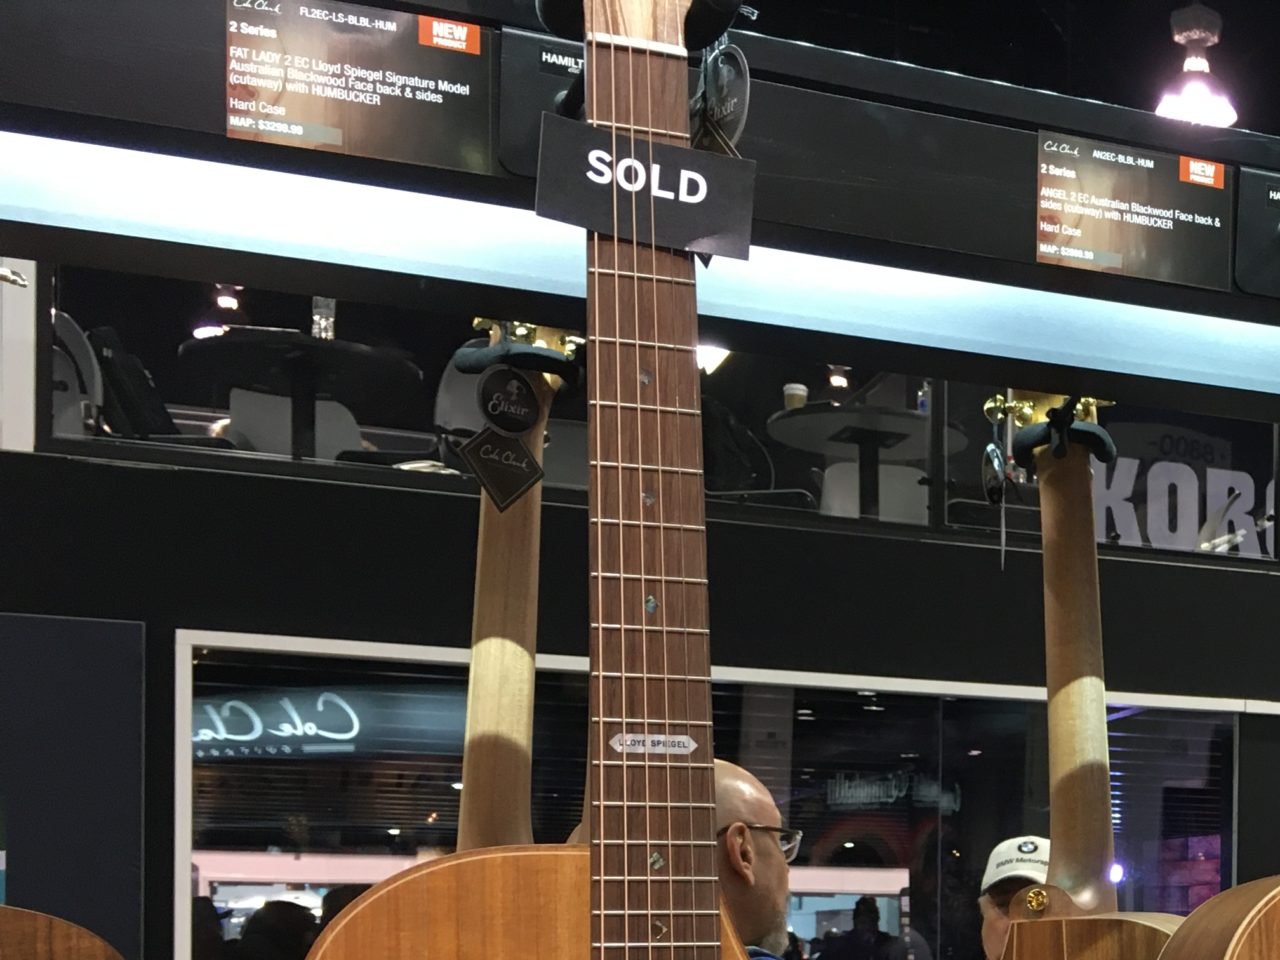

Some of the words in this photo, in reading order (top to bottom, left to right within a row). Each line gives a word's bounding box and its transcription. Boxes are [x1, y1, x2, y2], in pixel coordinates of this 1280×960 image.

[229, 21, 238, 32] 2
[240, 22, 277, 38] Series
[432, 21, 468, 41] NEW
[542, 51, 585, 69] HAMILT
[229, 46, 250, 59] FAT
[252, 50, 281, 64] LADY
[284, 55, 292, 66] 2
[295, 56, 309, 68] EC
[312, 59, 341, 75] Lloyd
[343, 64, 382, 82] Spiegel
[385, 71, 435, 88] Signature
[438, 80, 470, 95] Model
[229, 59, 284, 78] Australian
[287, 67, 345, 87] Blackwood
[348, 77, 373, 92] Face
[376, 82, 402, 97] back
[404, 87, 413, 98] &
[415, 90, 443, 103] sides
[229, 72, 282, 92] (cutaway)
[286, 82, 309, 94] with
[312, 84, 380, 105] HUMBUCKER
[230, 98, 256, 111] Hard
[259, 101, 286, 115] Case
[229, 116, 255, 128] MAP:
[585, 149, 708, 204] SOLD
[1040, 163, 1048, 173] 2
[1049, 165, 1076, 179] Series
[1189, 160, 1215, 178] NEW
[1040, 186, 1068, 200] ANGEL
[1070, 191, 1076, 202] 2
[1078, 192, 1089, 203] EC
[1090, 195, 1129, 211] Australian
[1131, 202, 1174, 218] Blackwood
[1175, 210, 1194, 222] Face
[1194, 214, 1213, 226] back
[1214, 217, 1221, 228] &
[1040, 199, 1063, 211] sides
[1104, 210, 1121, 221] with
[1122, 212, 1173, 229] HUMBUCKER
[1040, 221, 1060, 233] Hard
[1061, 224, 1082, 237] Case
[488, 392, 529, 416] Elixir
